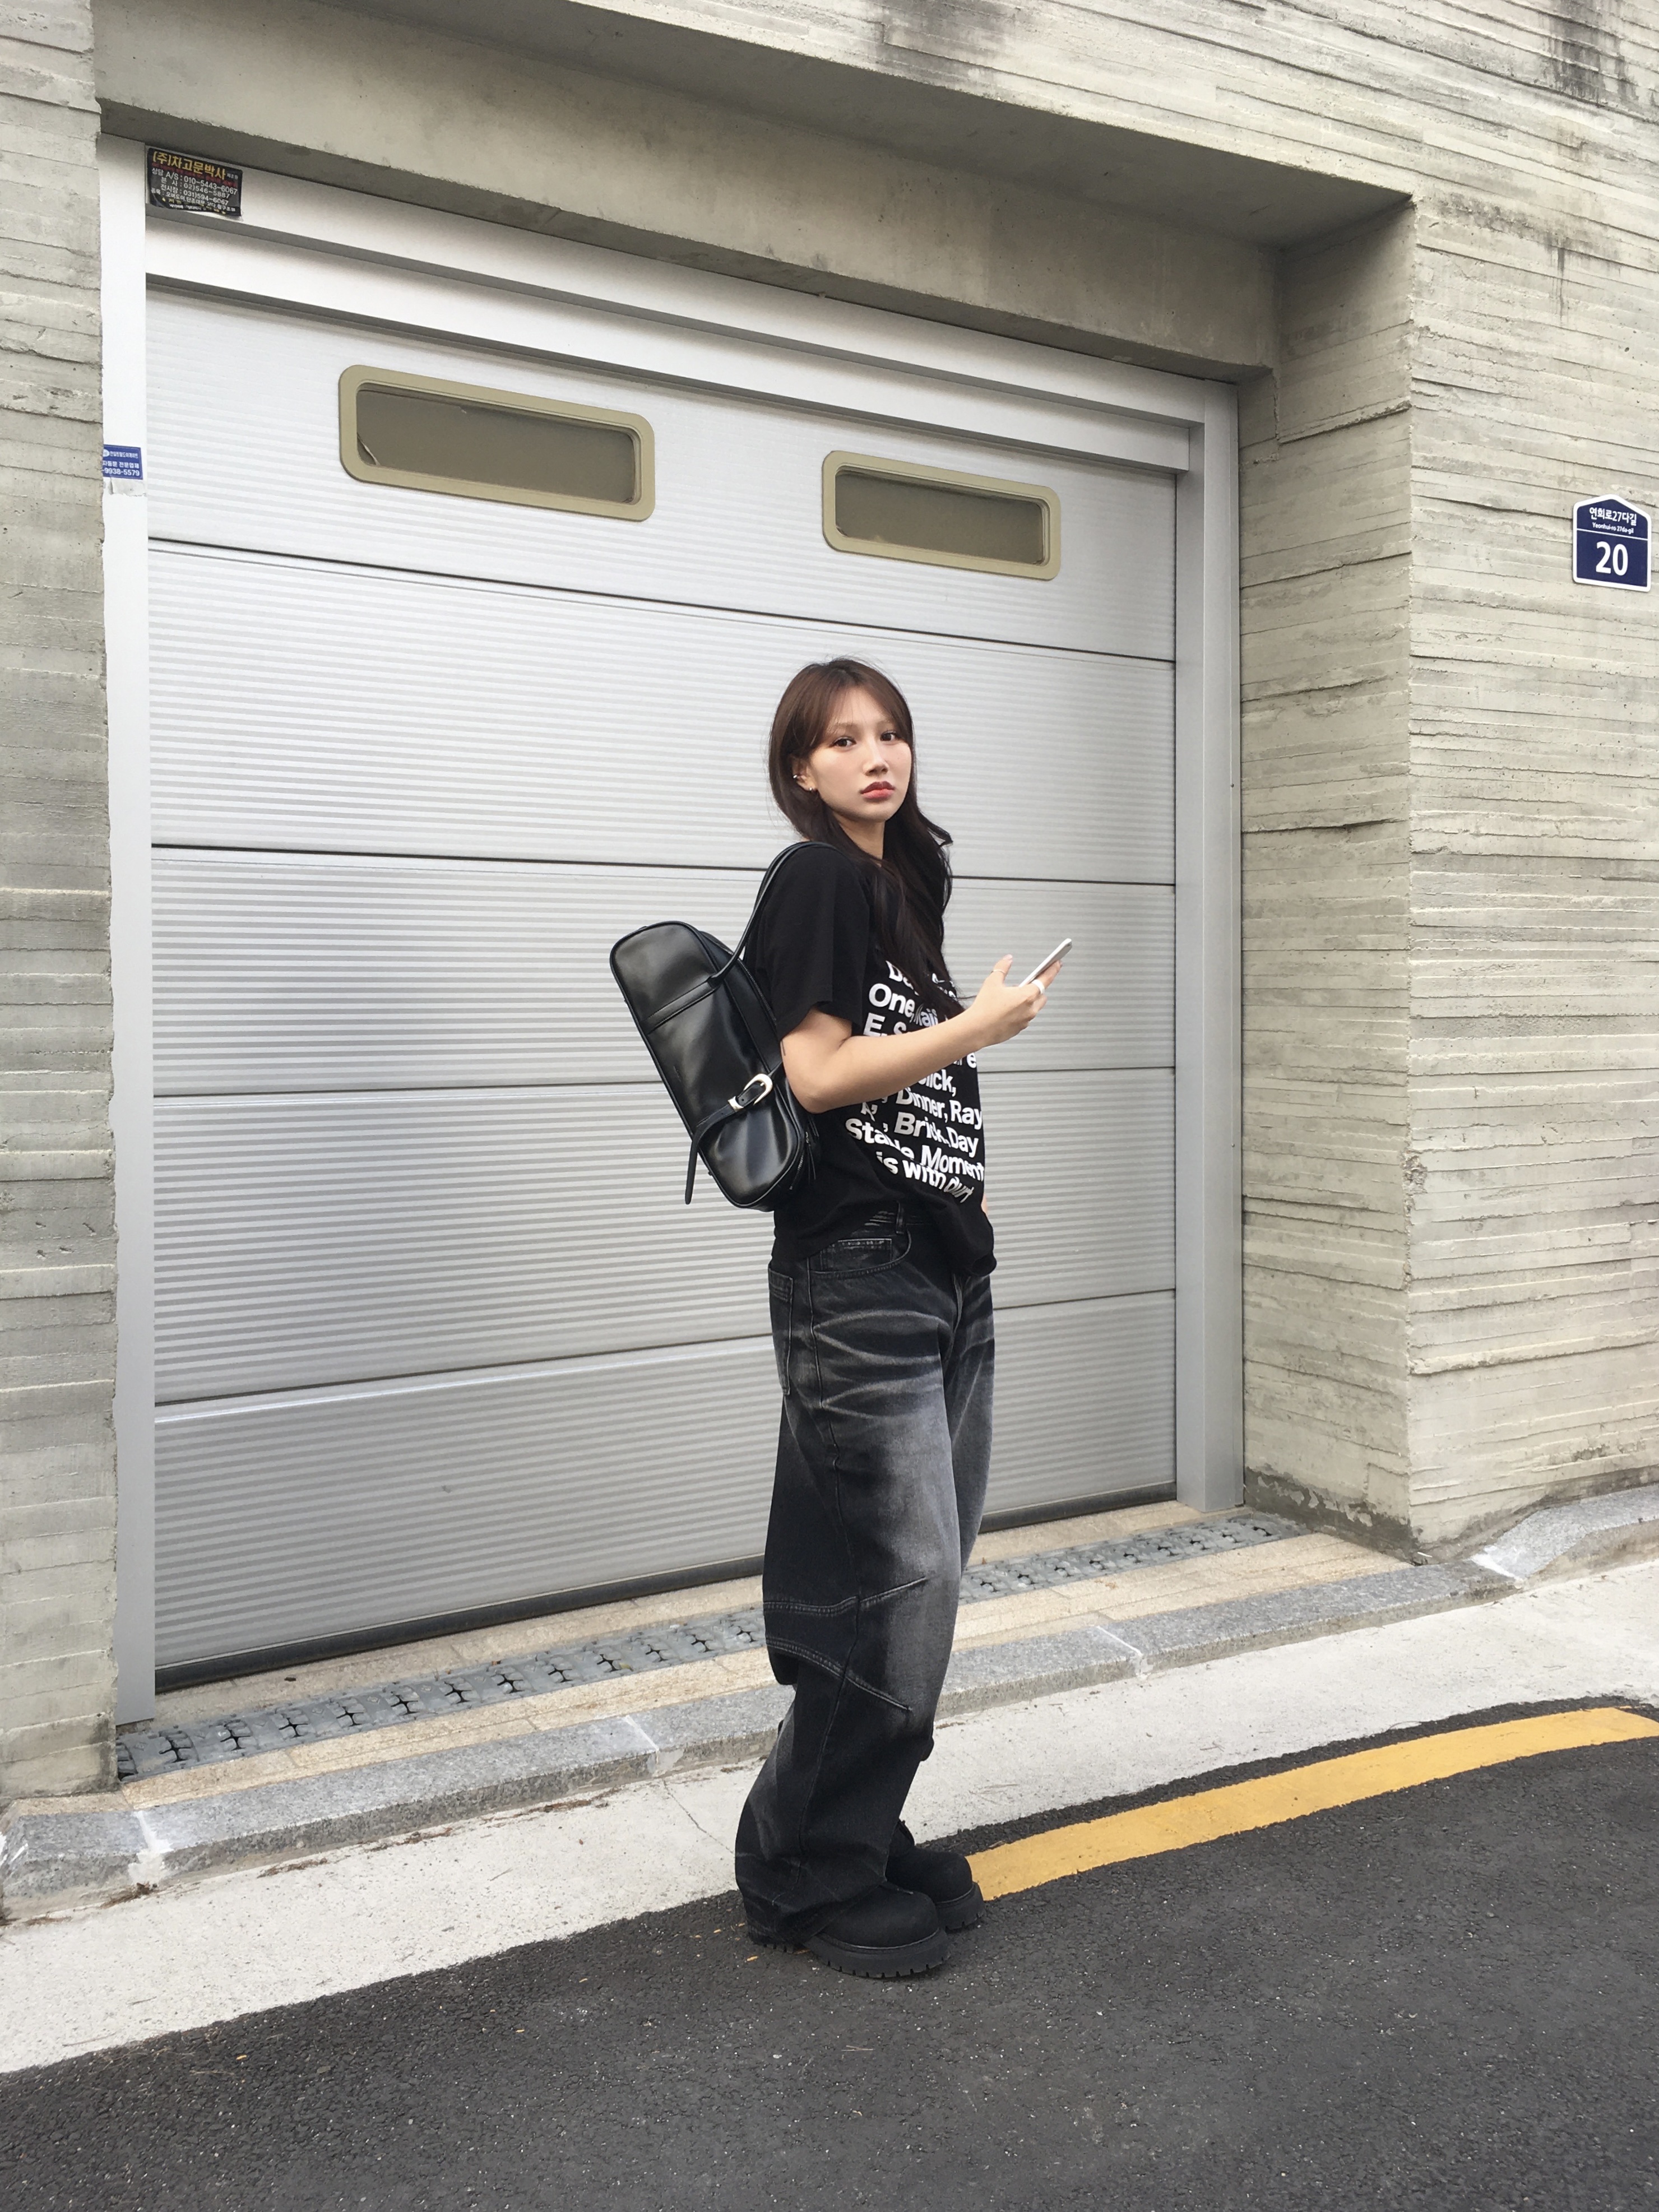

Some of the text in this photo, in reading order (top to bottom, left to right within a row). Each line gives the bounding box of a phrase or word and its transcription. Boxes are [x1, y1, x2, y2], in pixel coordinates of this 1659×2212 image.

[166, 171, 179, 180] A/S
[184, 176, 238, 195] 010-5443-6067
[183, 190, 229, 206] 031)594-6067
[1590, 507, 1637, 526] 연희로27다길
[1592, 522, 1634, 534] Yeonhui-ro 27da-gil
[1596, 541, 1628, 576] 20
[896, 1087, 948, 1123] Dinner,
[949, 1100, 982, 1130] Ray
[946, 1126, 979, 1158] Day
[875, 1151, 898, 1175] is
[902, 1160, 947, 1190] with
[920, 1145, 984, 1181] Moment
